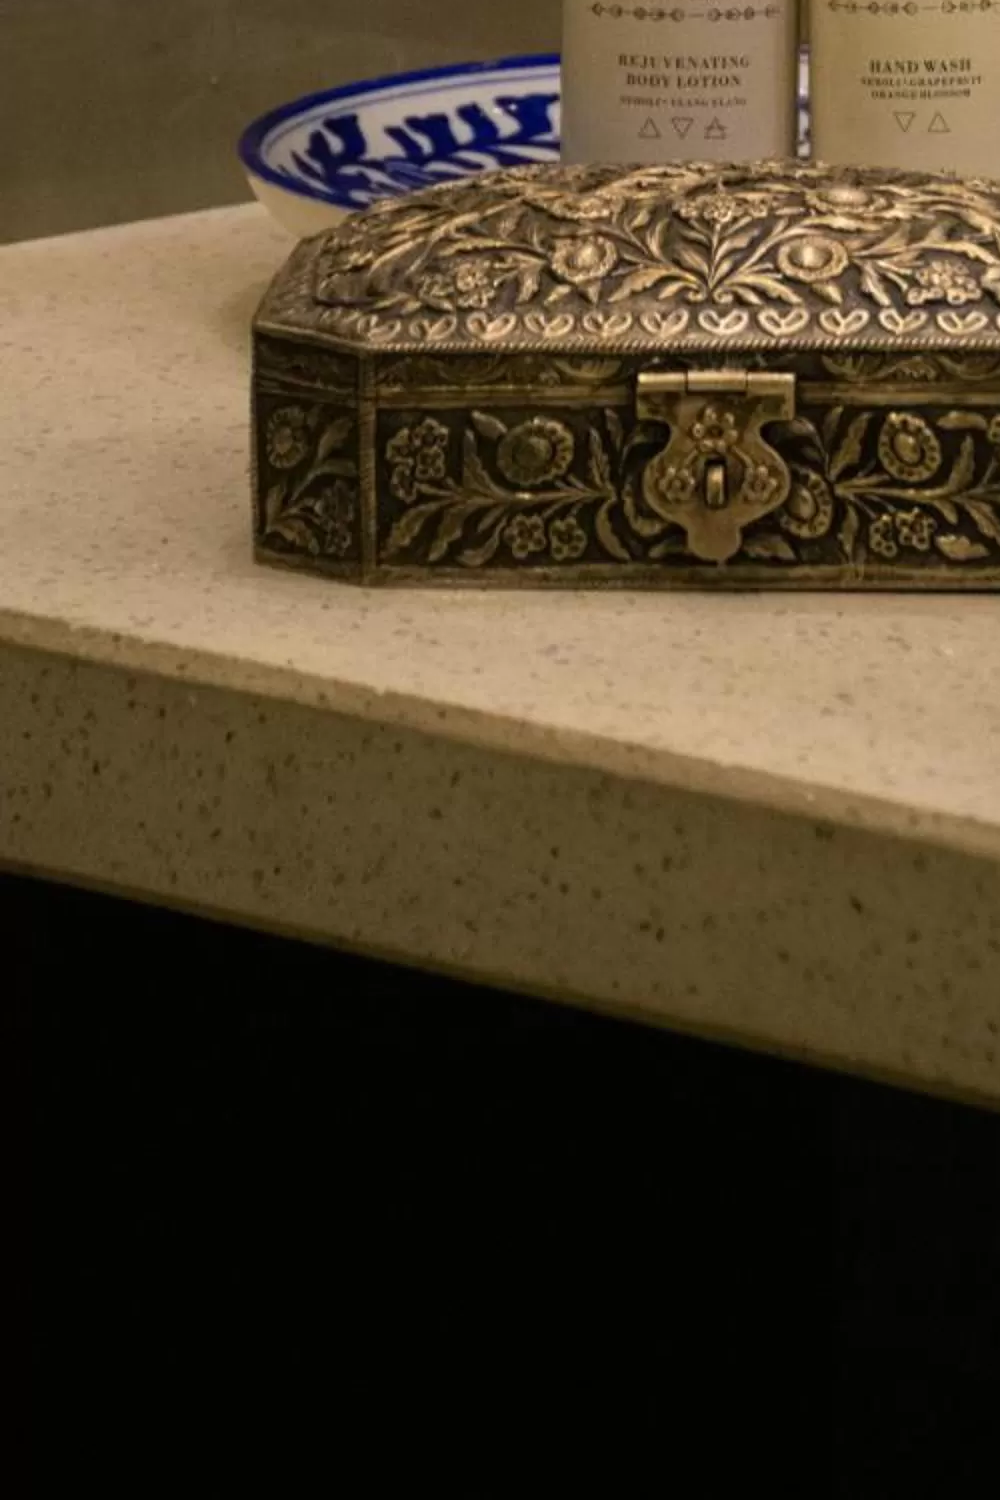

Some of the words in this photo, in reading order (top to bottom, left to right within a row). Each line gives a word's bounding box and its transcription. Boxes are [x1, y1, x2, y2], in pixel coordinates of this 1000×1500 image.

[618, 54, 749, 69] REJUVENATING
[869, 59, 919, 74] HAND
[923, 58, 971, 73] WASH
[626, 73, 670, 88] BODY
[676, 75, 741, 89] LOTION
